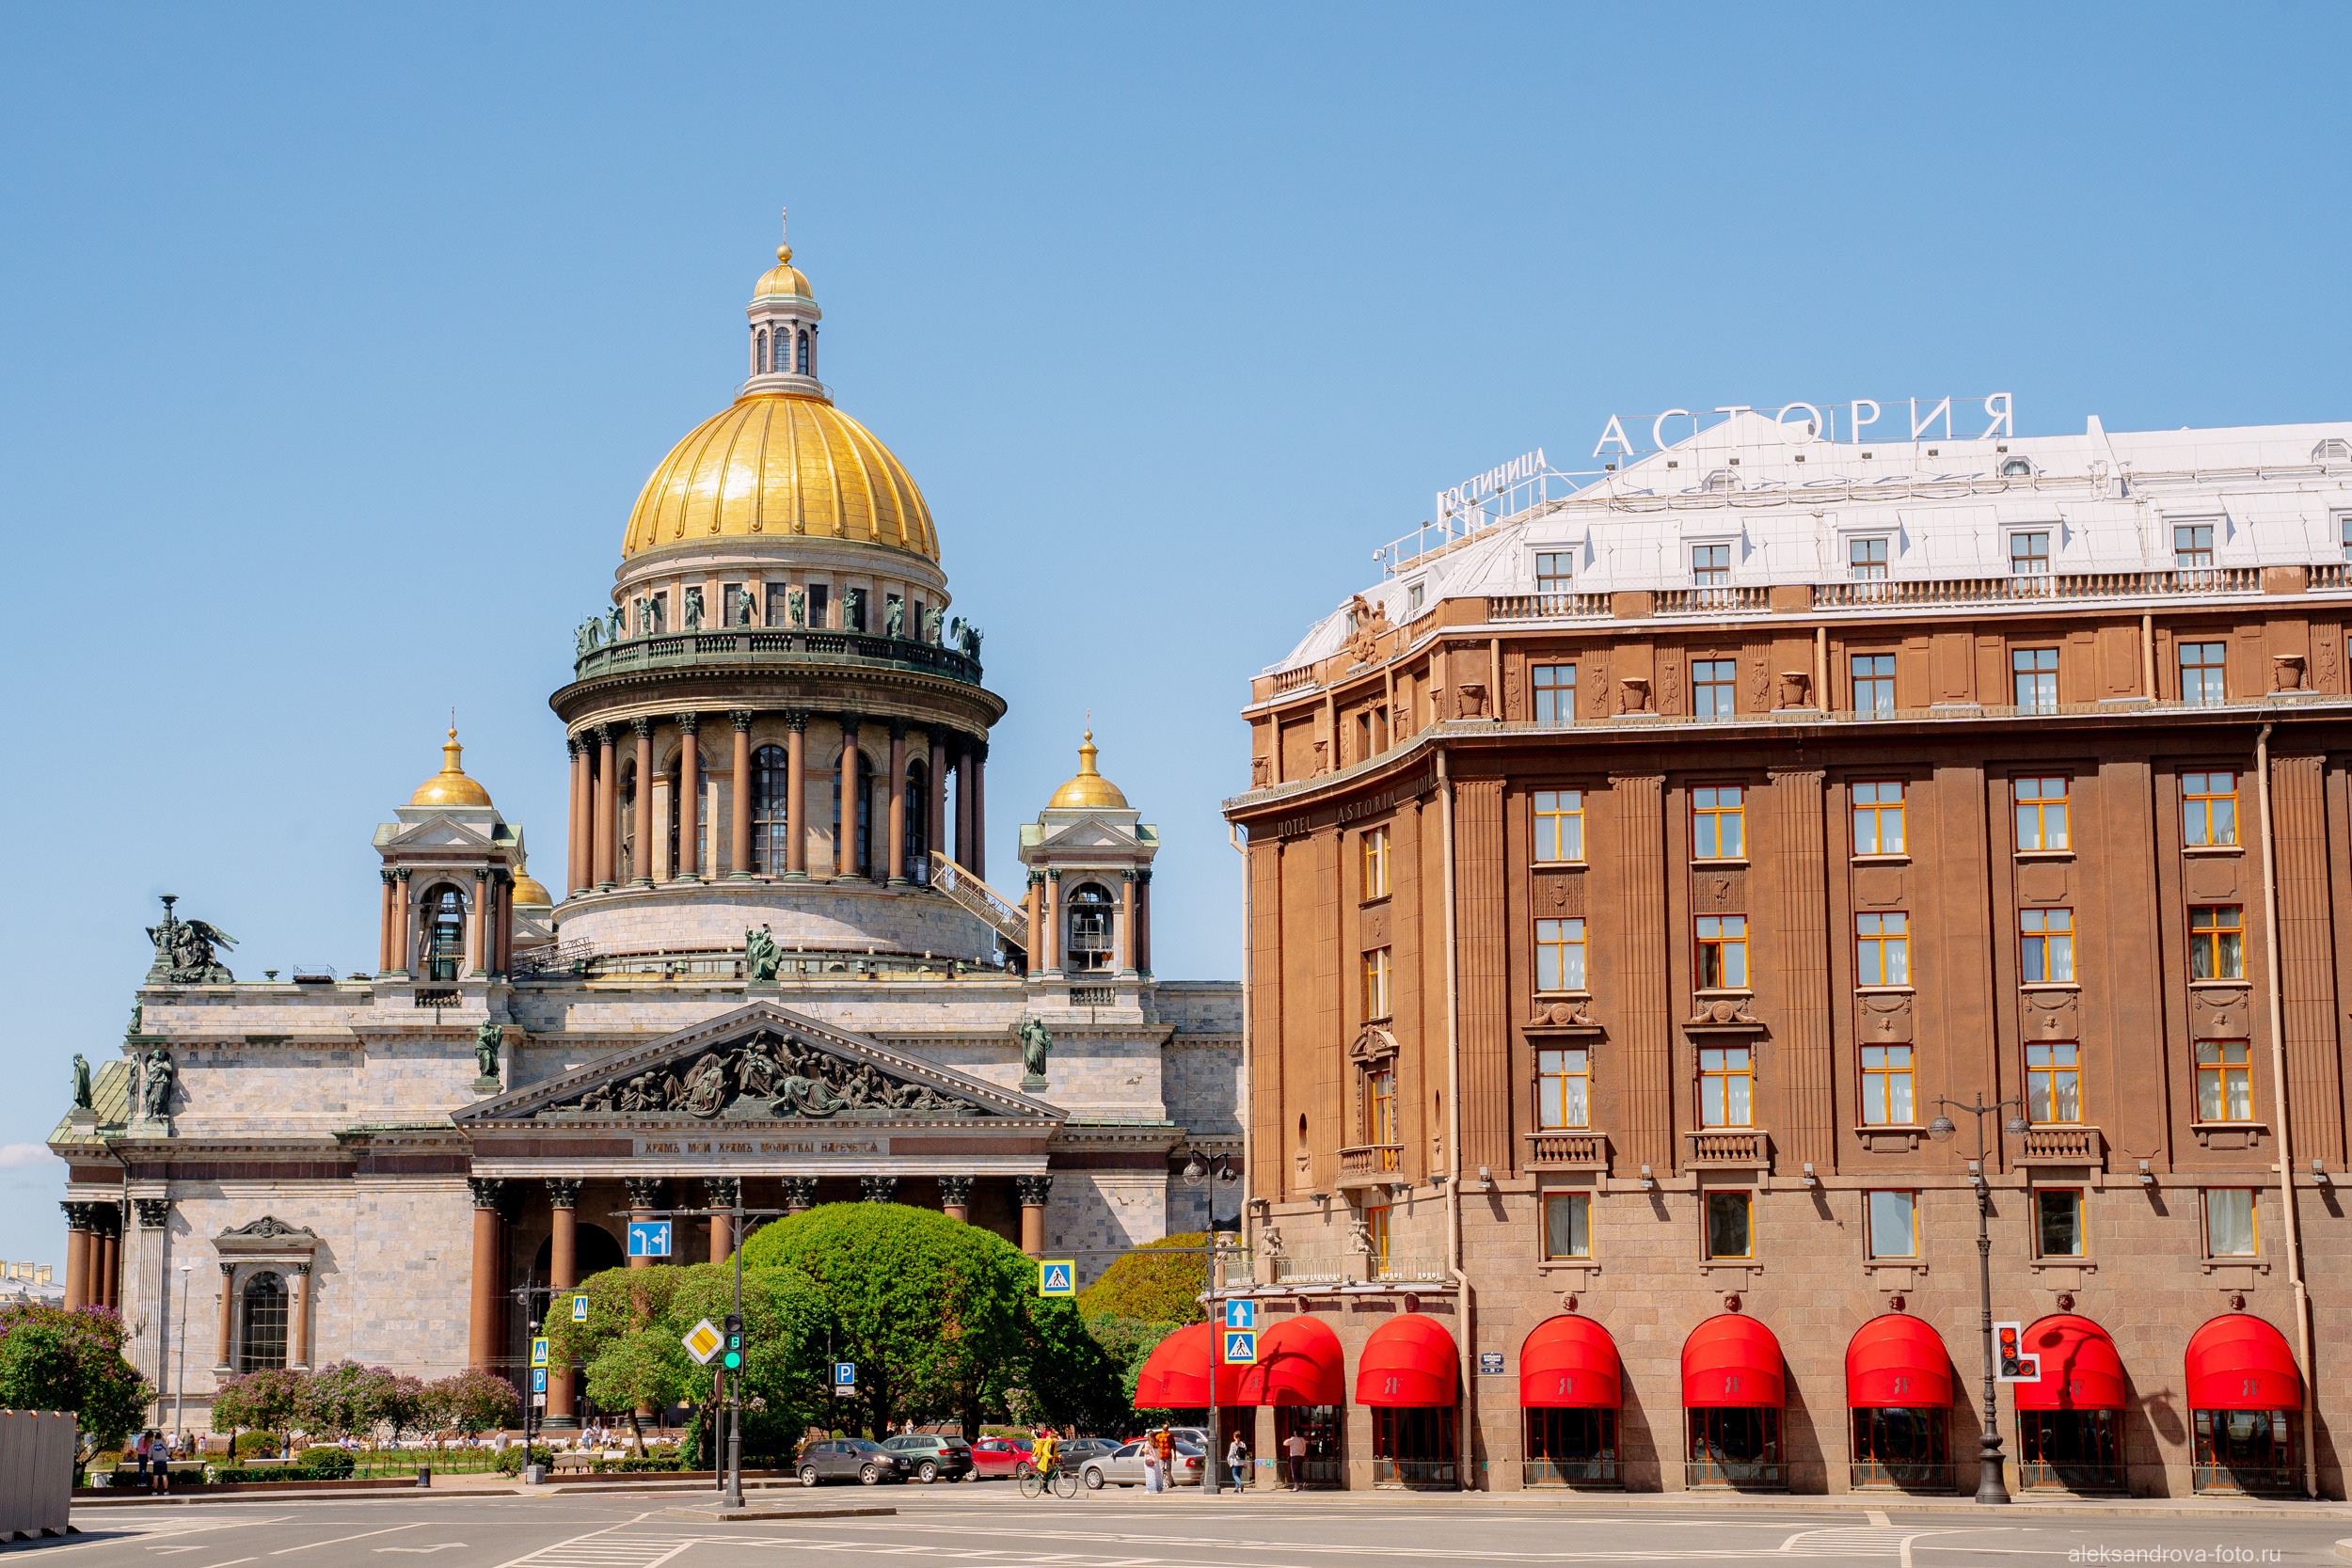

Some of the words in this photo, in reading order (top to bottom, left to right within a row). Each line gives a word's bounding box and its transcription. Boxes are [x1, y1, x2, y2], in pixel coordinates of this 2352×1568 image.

[1593, 392, 2013, 458] АСТОРИЯ
[1437, 447, 1547, 515] ГОСТИНИЦА
[1278, 816, 1311, 837] HOTEL
[1337, 791, 1396, 823] ASTORIA
[645, 1142, 680, 1154] ХРАМЪ
[718, 1142, 754, 1154] ХРАМЪ
[760, 1142, 814, 1153] МОЛИТВЫ
[2003, 1346, 2015, 1357] 55
[536, 1371, 544, 1389] P
[841, 1366, 850, 1382] P
